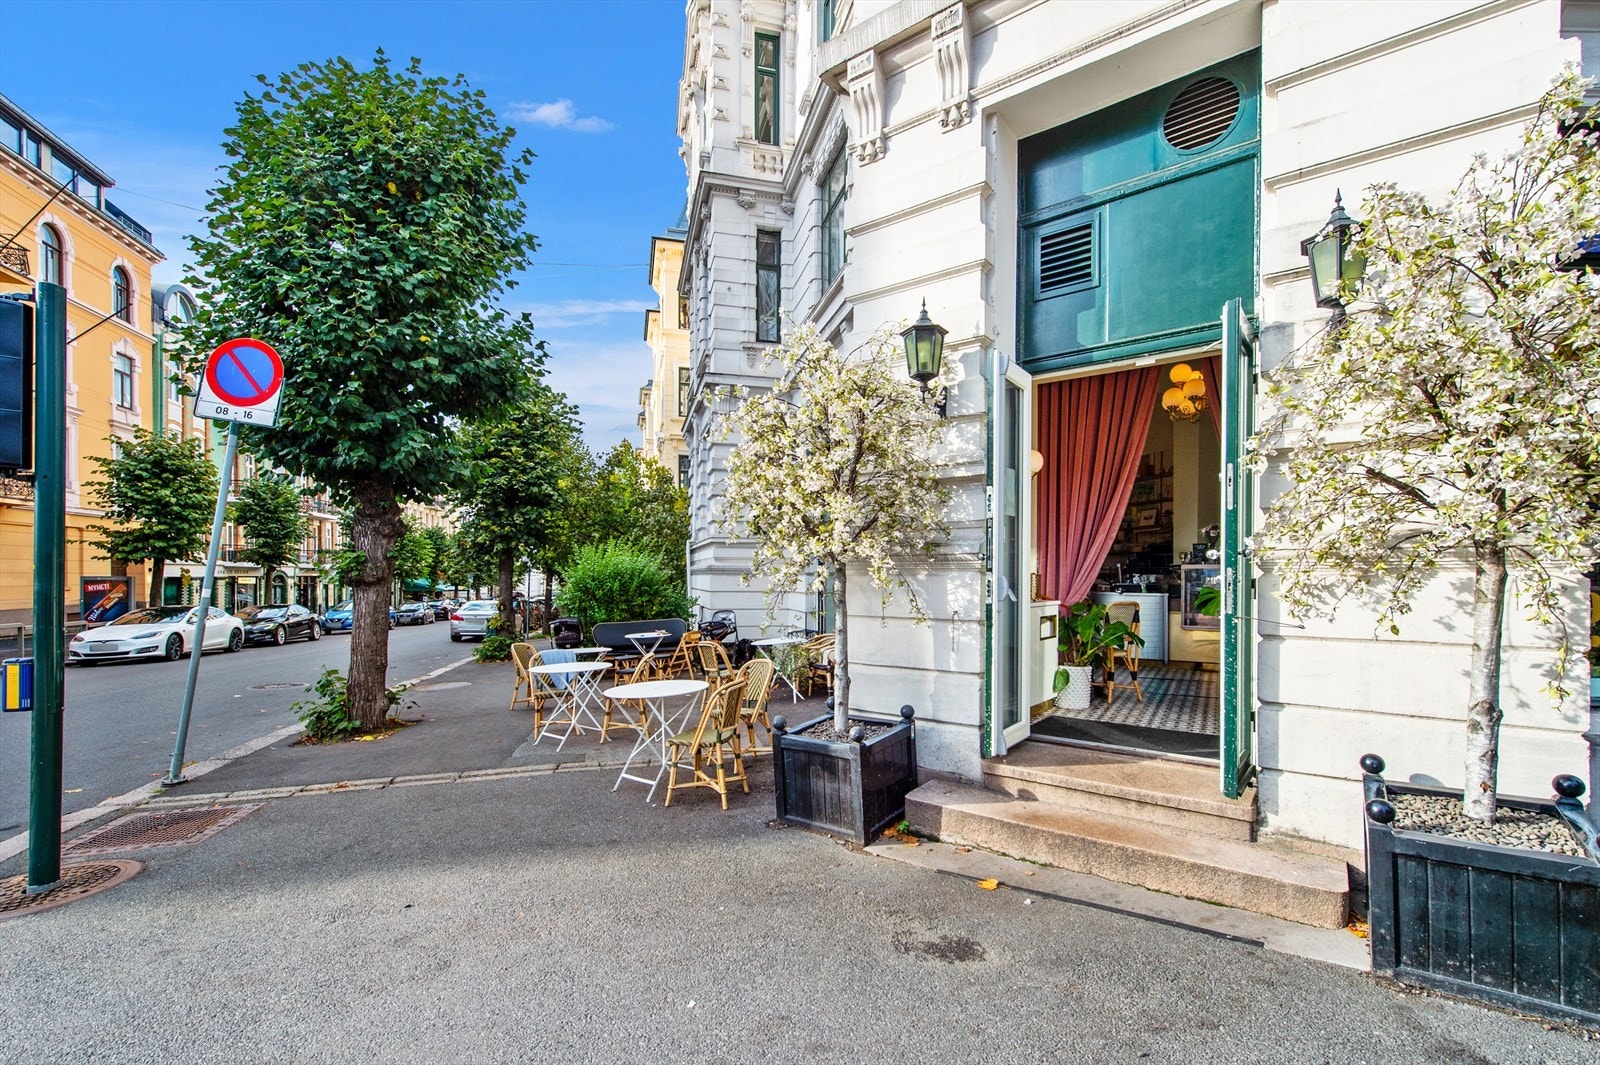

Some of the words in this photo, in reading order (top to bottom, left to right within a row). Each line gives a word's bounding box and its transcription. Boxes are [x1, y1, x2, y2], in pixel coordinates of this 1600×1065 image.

[215, 406, 229, 415] 08
[243, 410, 253, 419] 16
[88, 583, 110, 592] NYHET!
